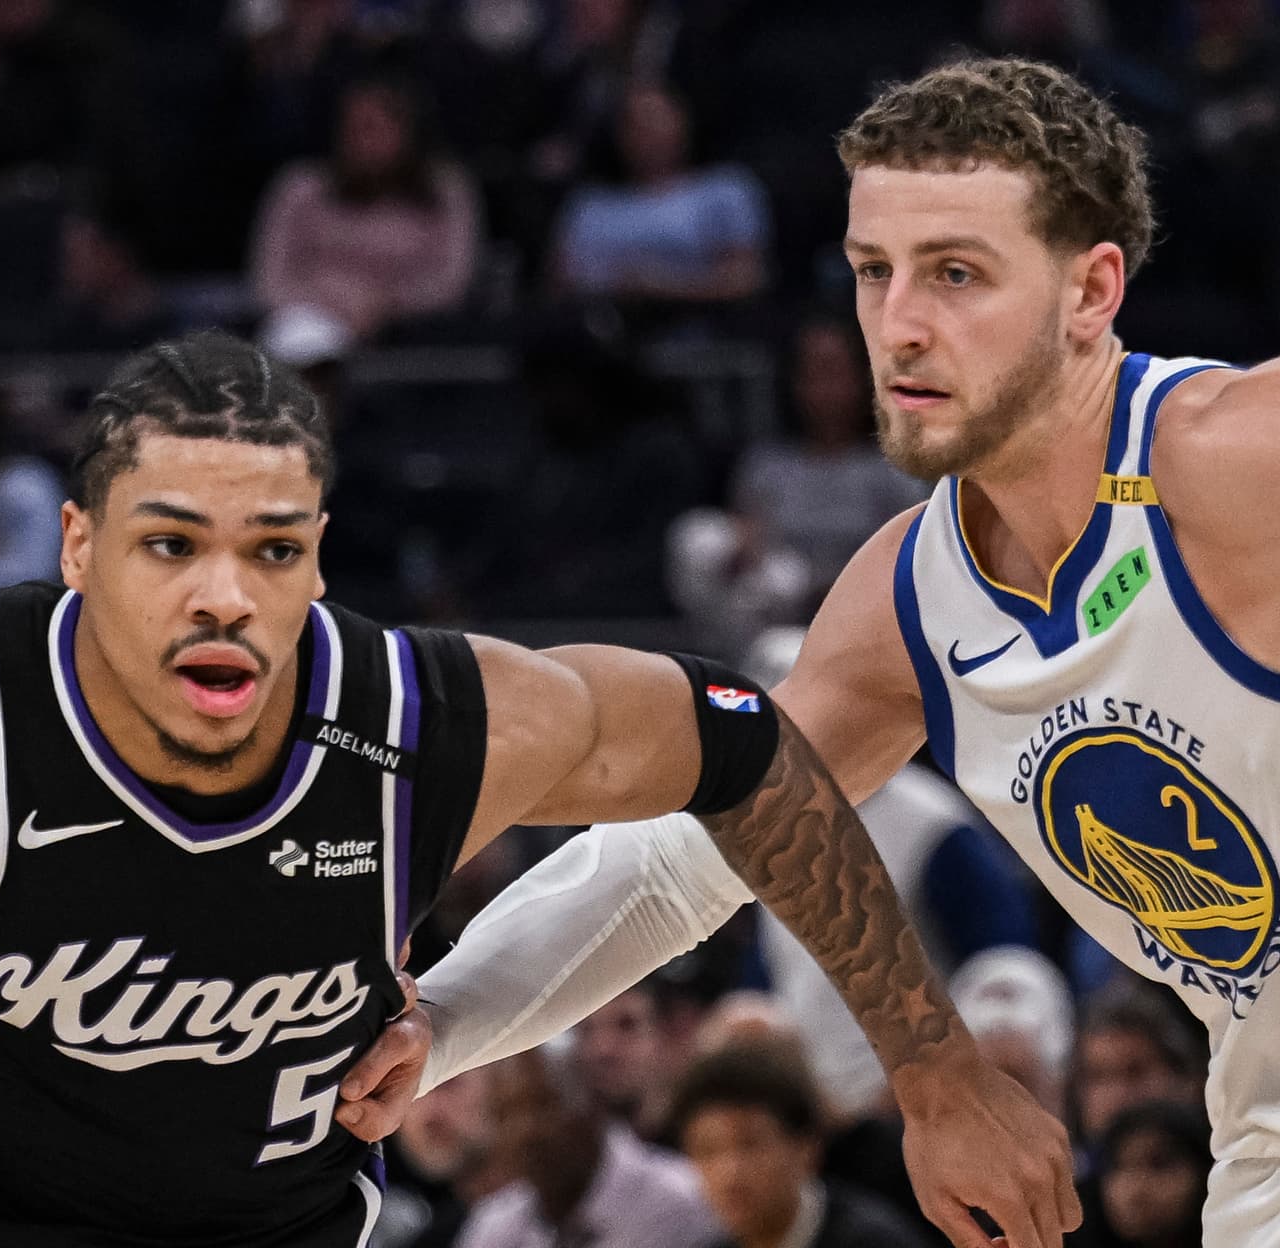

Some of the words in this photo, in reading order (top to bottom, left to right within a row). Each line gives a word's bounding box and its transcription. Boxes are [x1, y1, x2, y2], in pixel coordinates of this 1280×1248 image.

[1088, 555, 1144, 629] IREN
[316, 725, 401, 769] ADELMAN
[1010, 697, 1089, 804] GOLDEN
[1103, 697, 1206, 763] STATE
[315, 840, 378, 859] Sutter
[1160, 785, 1218, 851] 2
[314, 857, 378, 878] Health
[251, 1043, 360, 1168] 5
